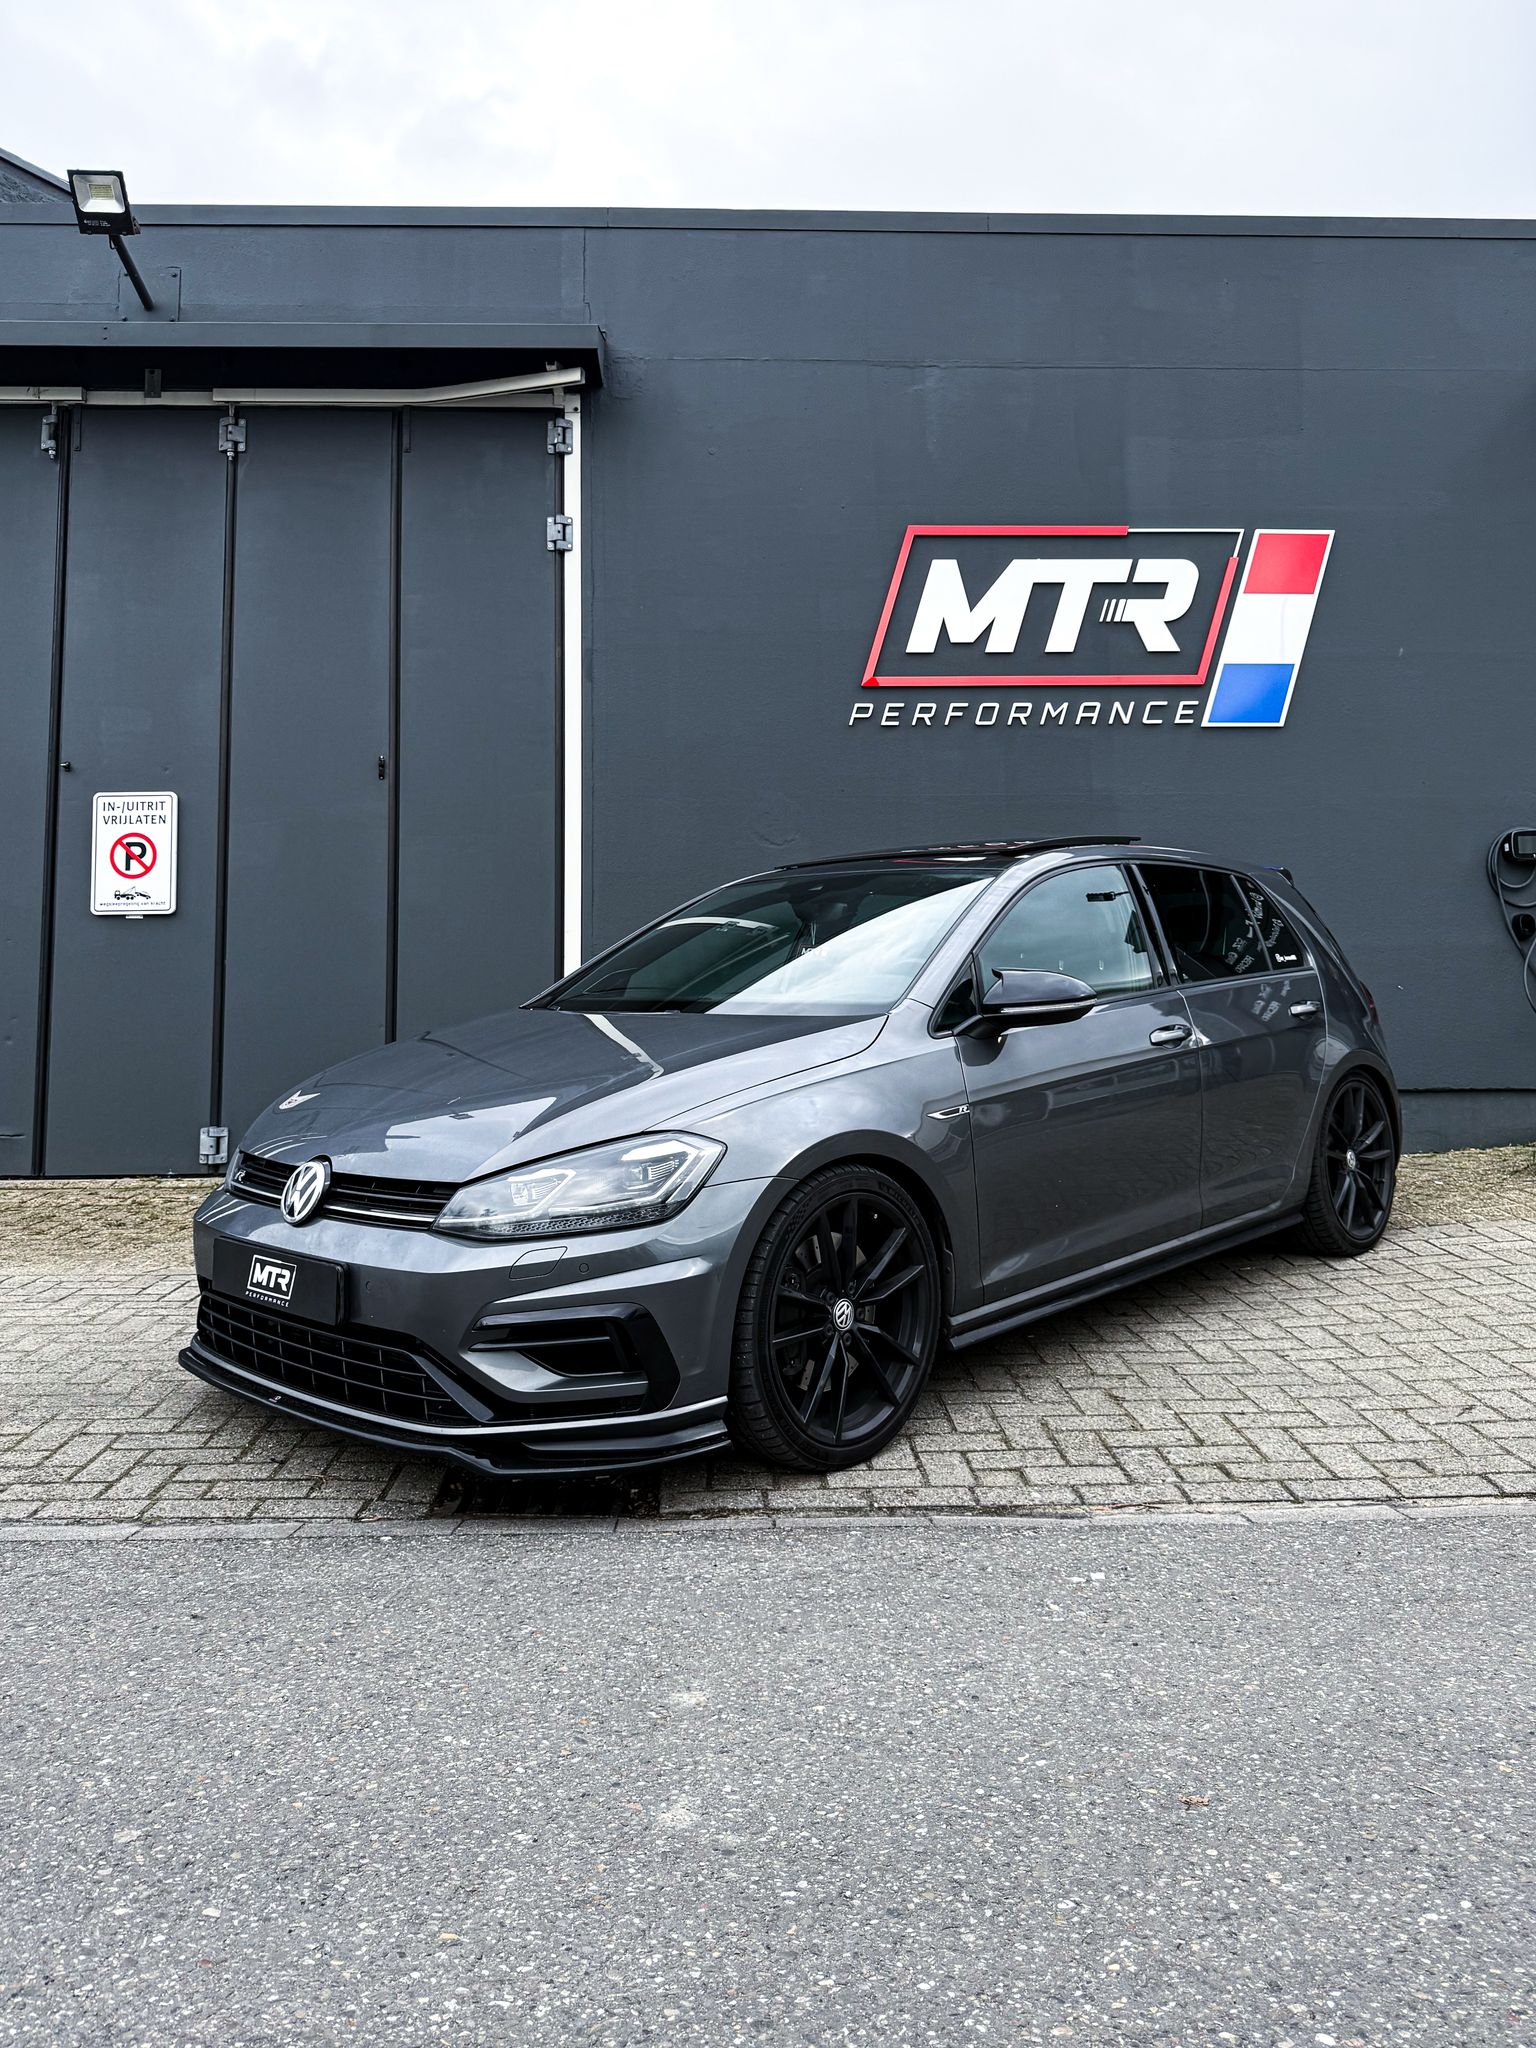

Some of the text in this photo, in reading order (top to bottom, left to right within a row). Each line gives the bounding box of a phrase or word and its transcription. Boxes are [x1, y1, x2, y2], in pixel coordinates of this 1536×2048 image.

[905, 558, 1200, 654] MTR
[848, 700, 1200, 727] PERFORMANCE
[102, 801, 166, 814] IN-/UITRIT
[102, 814, 167, 825] VRIJLATEN
[252, 1262, 291, 1292] MTR
